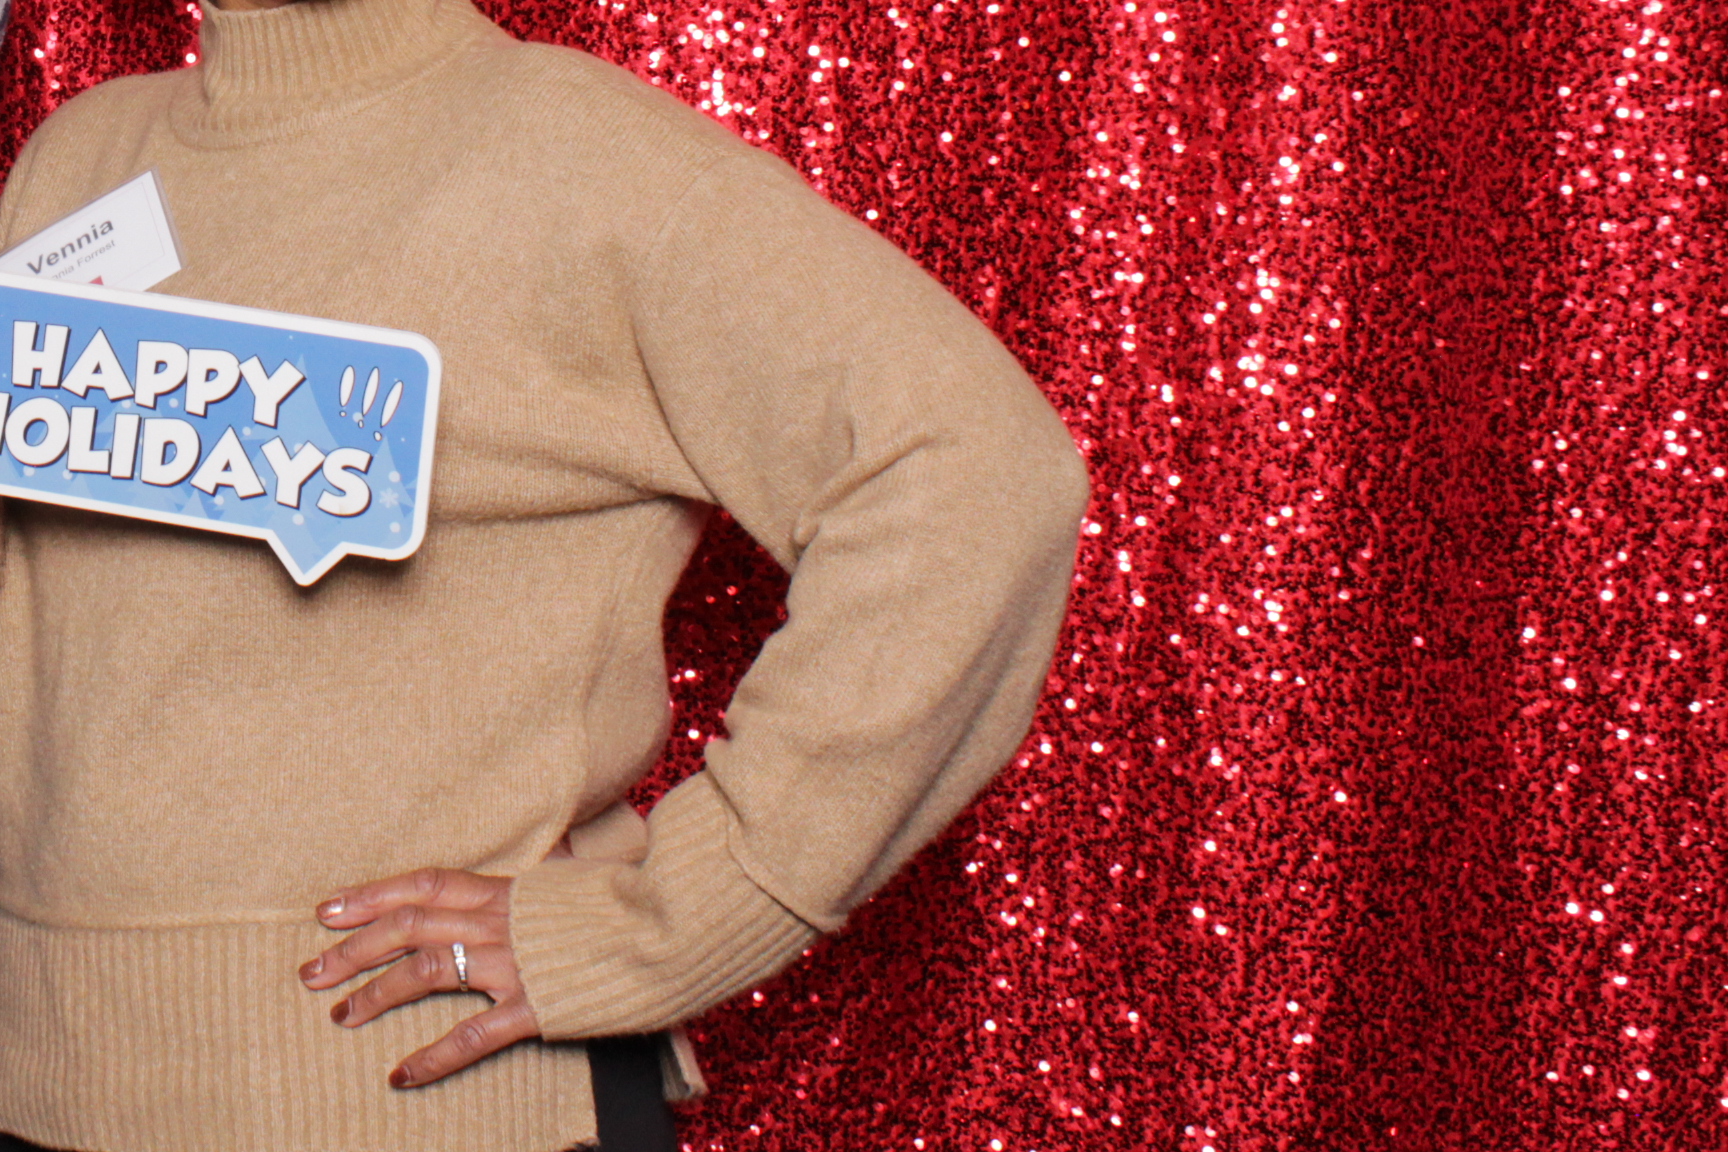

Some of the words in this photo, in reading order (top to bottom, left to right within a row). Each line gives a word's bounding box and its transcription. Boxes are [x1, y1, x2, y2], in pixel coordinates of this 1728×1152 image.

[26, 219, 115, 275] Vennia
[76, 239, 116, 268] Forrest
[11, 319, 306, 428] HAPPY
